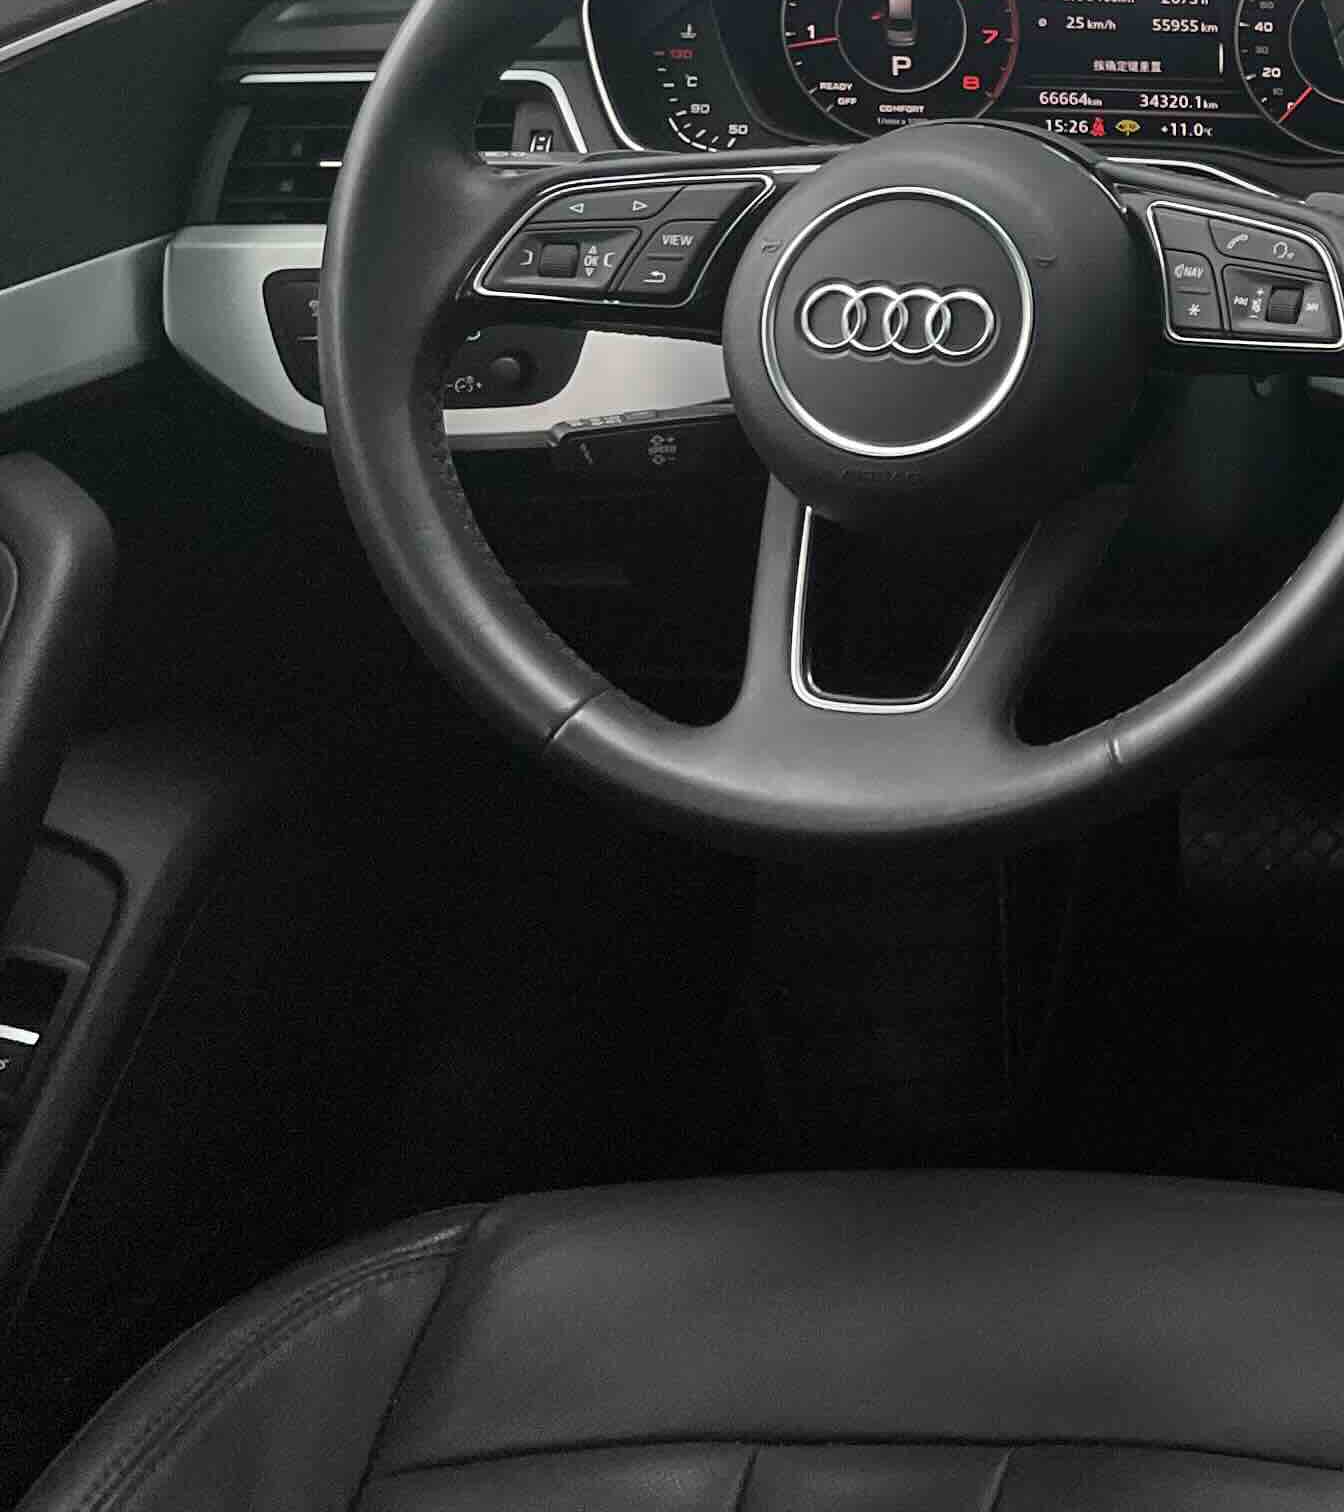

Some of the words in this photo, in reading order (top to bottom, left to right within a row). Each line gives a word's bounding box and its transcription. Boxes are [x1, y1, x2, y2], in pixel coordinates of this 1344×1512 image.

[806, 24, 816, 39] 1
[1066, 16, 1085, 30] 25
[1152, 18, 1199, 33] 55955
[1200, 21, 1218, 34] km
[1253, 21, 1274, 33] 40
[981, 29, 999, 44] 7
[891, 55, 912, 76] P
[1261, 67, 1281, 79] 20
[819, 82, 853, 91] READY
[962, 76, 981, 91] 8
[690, 104, 711, 115] 90
[728, 124, 749, 135] 50
[1045, 119, 1089, 134] 15:26
[661, 235, 695, 247] VIEW
